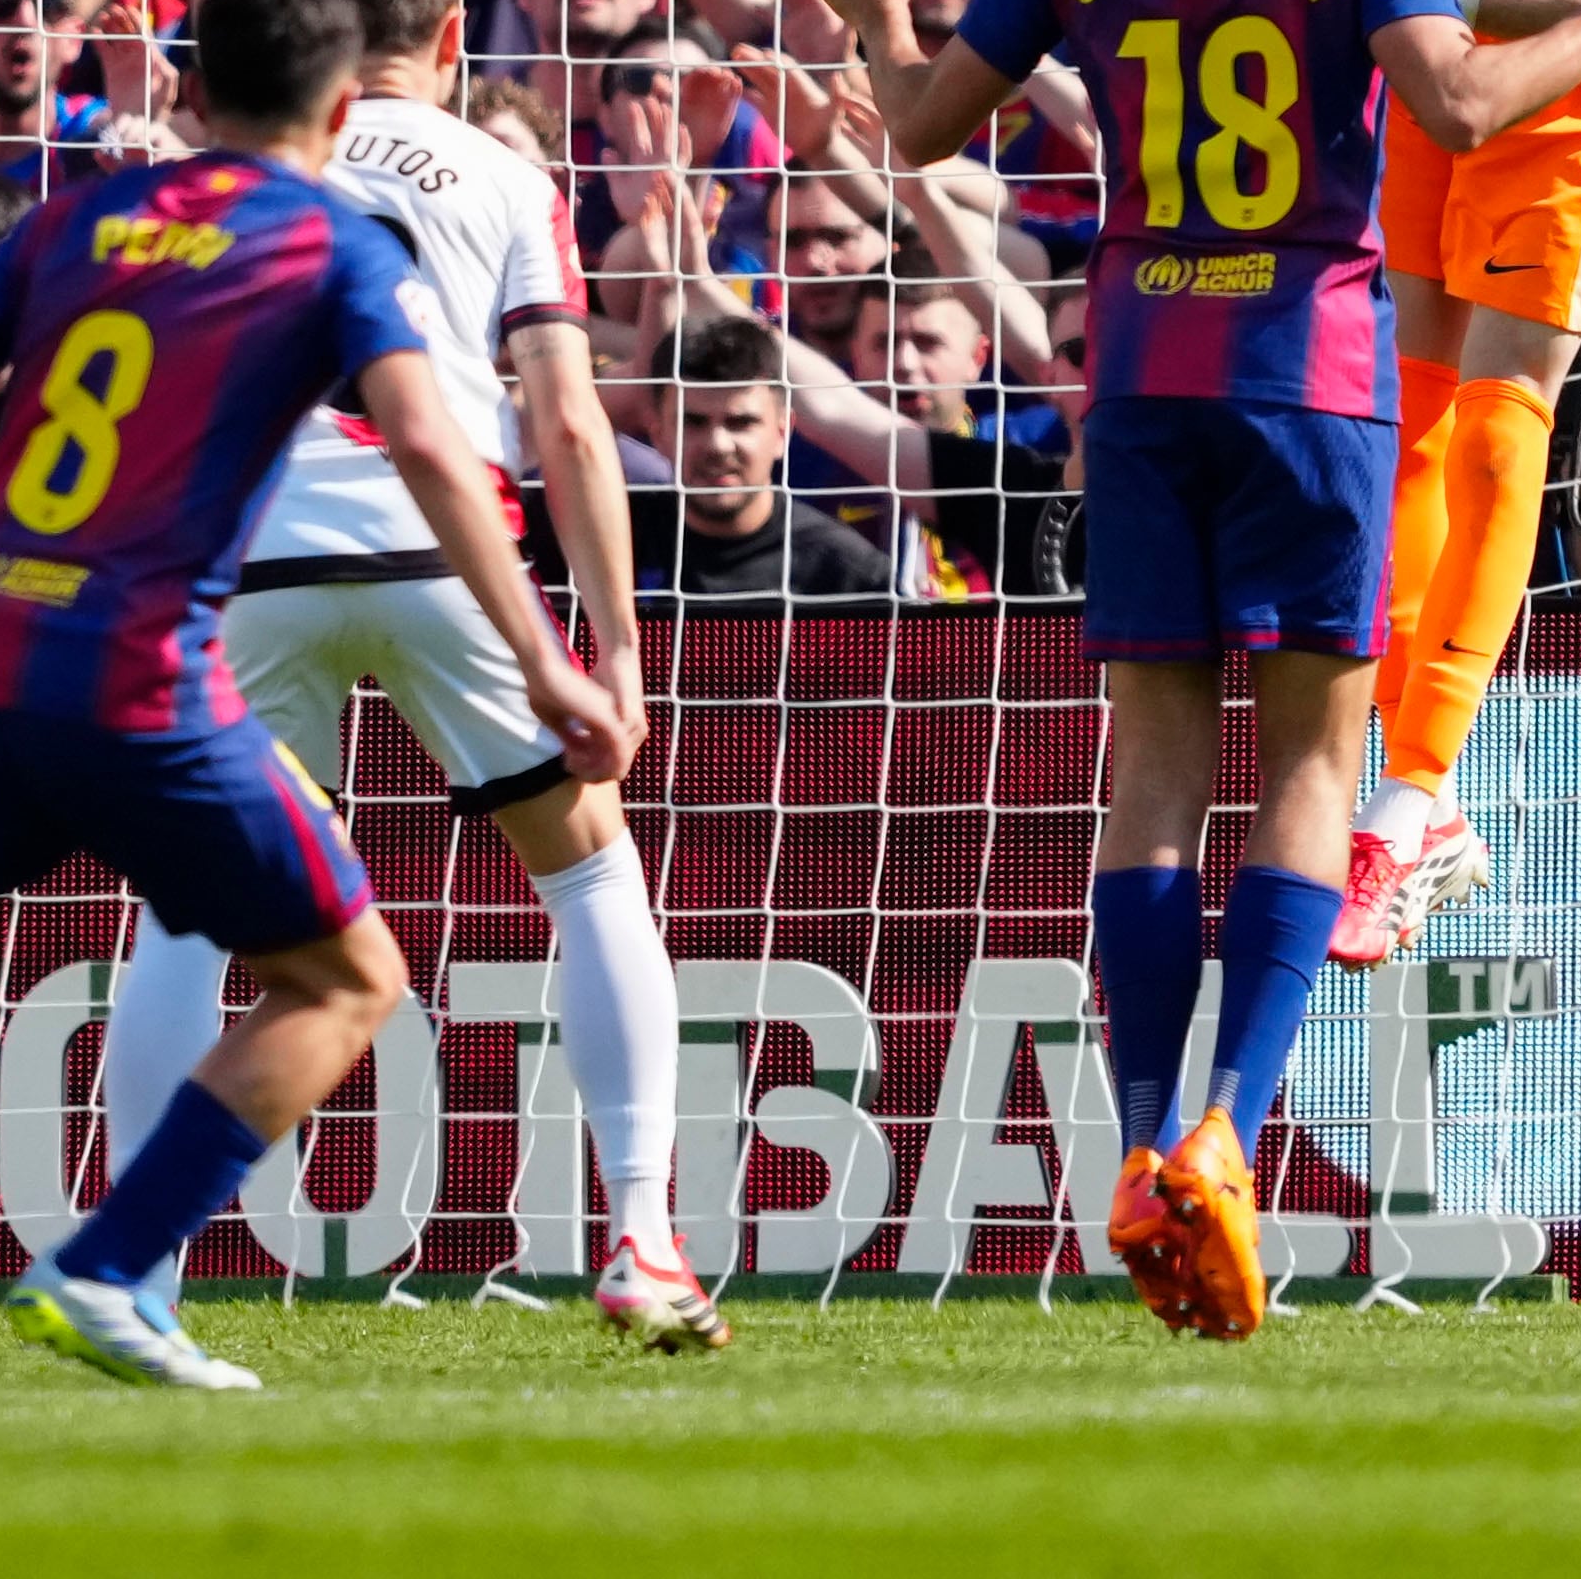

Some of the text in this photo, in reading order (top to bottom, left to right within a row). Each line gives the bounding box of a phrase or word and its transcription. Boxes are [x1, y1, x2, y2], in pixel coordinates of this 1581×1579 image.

[345, 134, 458, 194] UTOS
[1116, 14, 1301, 231] 18
[1197, 252, 1276, 275] UNHCR
[6, 308, 155, 535] 8
